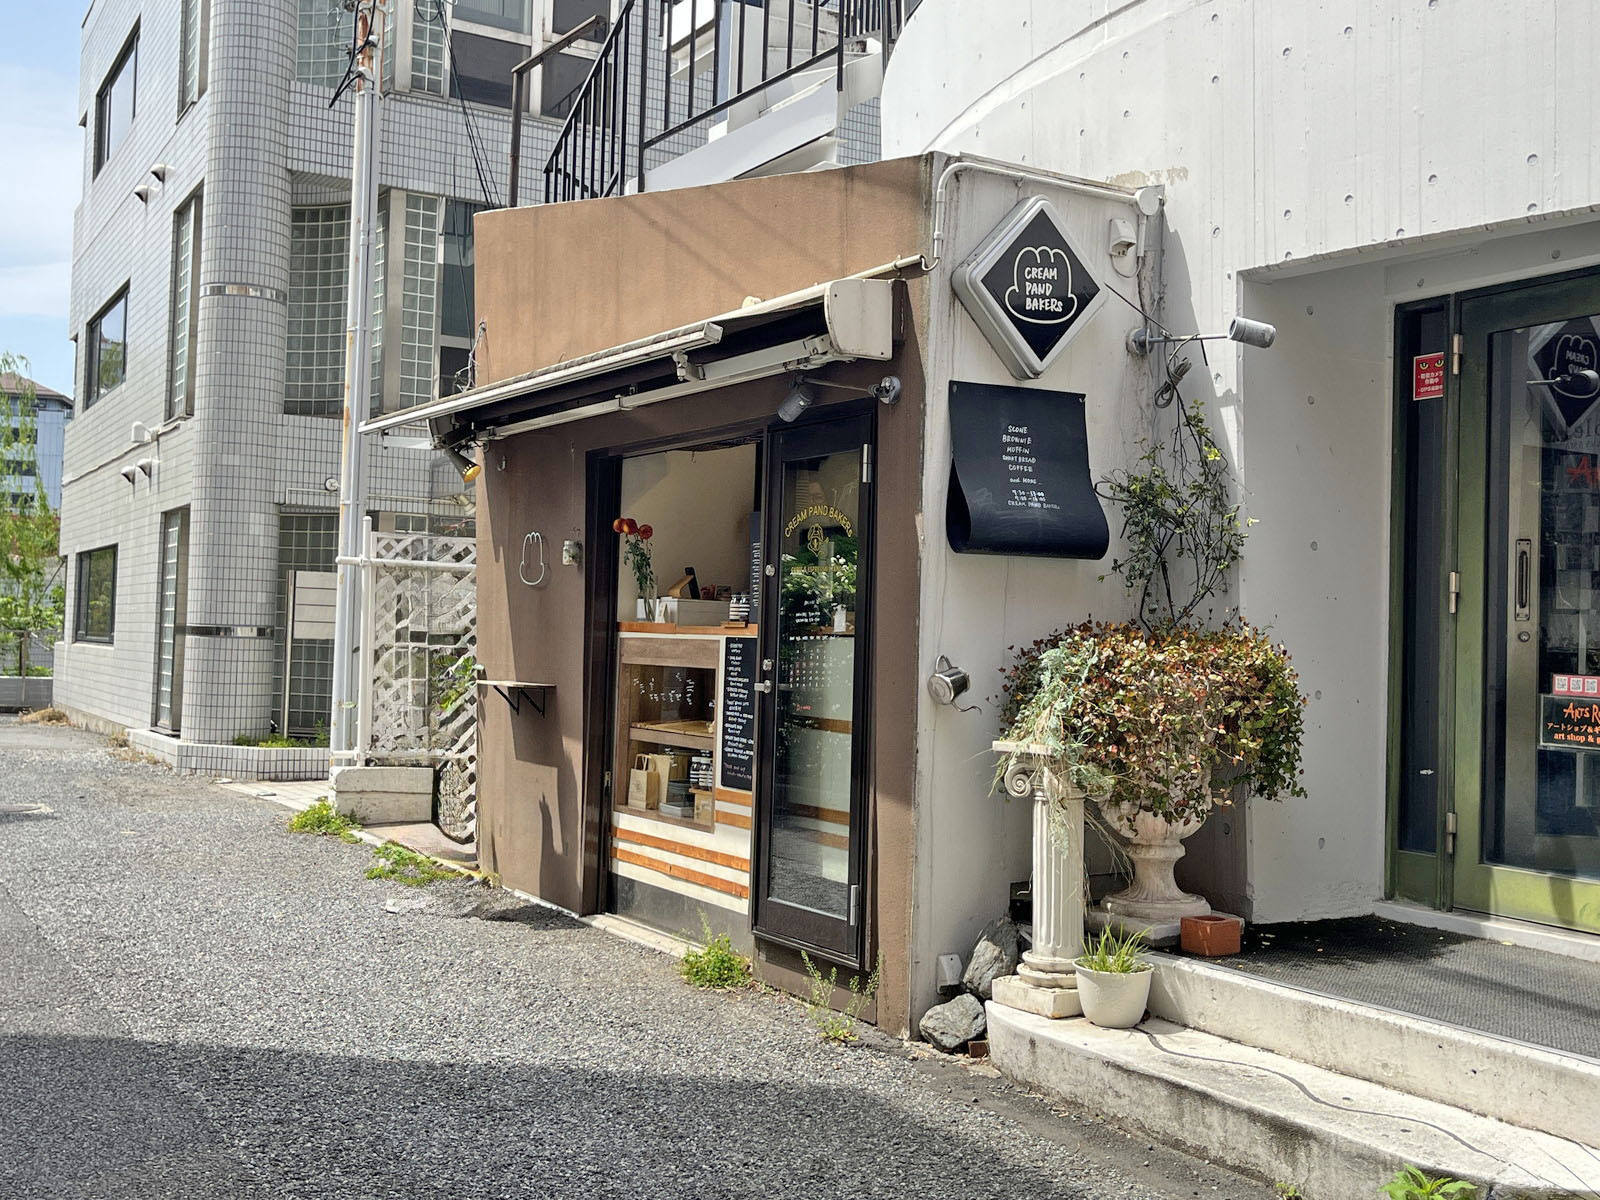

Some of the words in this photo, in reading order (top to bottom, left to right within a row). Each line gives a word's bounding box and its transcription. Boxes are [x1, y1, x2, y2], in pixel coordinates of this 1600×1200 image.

[1024, 267, 1058, 280] CREAM
[1025, 282, 1053, 296] PAND
[1025, 298, 1064, 312] BAKERS
[1008, 425, 1028, 434] SCONE
[1002, 434, 1032, 444] BROWNIE
[1006, 446, 1030, 454] MUFFIN
[1008, 464, 1033, 472] COFFEE
[784, 509, 808, 538] CREAM
[808, 505, 828, 517] PAND
[828, 507, 853, 538] BAKERS
[1563, 702, 1590, 722] ARTS
[1554, 732, 1565, 740] art
[1567, 733, 1586, 743] shop
